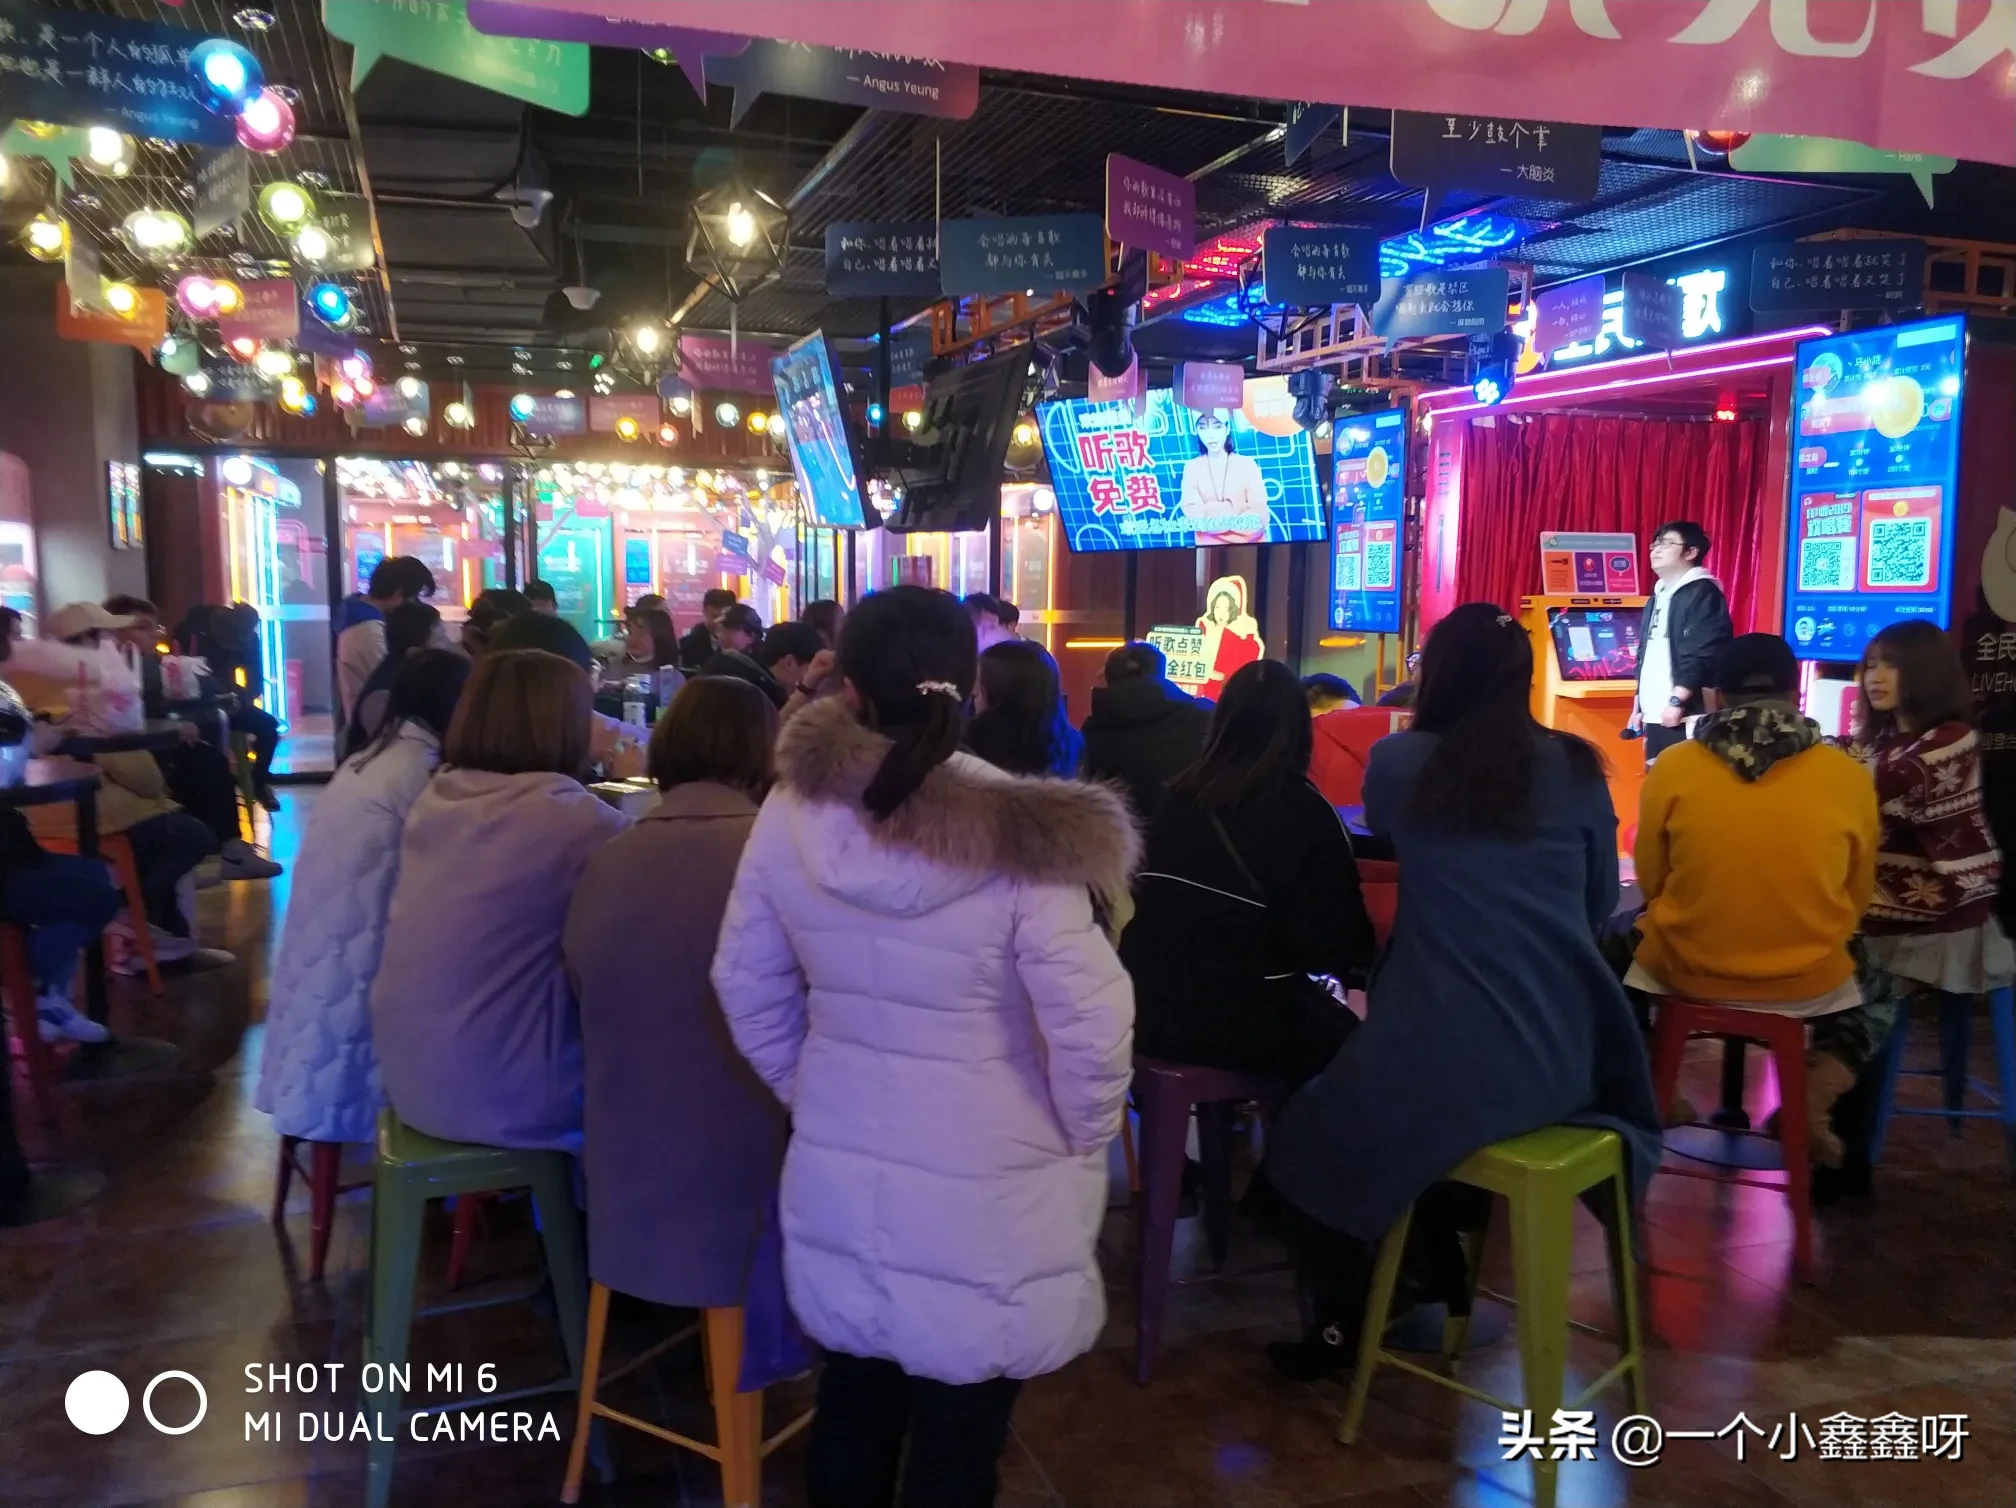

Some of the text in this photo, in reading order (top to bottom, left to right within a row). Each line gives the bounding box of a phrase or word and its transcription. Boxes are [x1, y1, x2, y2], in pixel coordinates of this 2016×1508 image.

[864, 75, 939, 99] Angus Yeung
[1442, 117, 1550, 152] 至少鼓个掌
[1078, 430, 1155, 471] 听歌
[1088, 475, 1164, 515] 免费
[1167, 659, 1206, 678] 金红包
